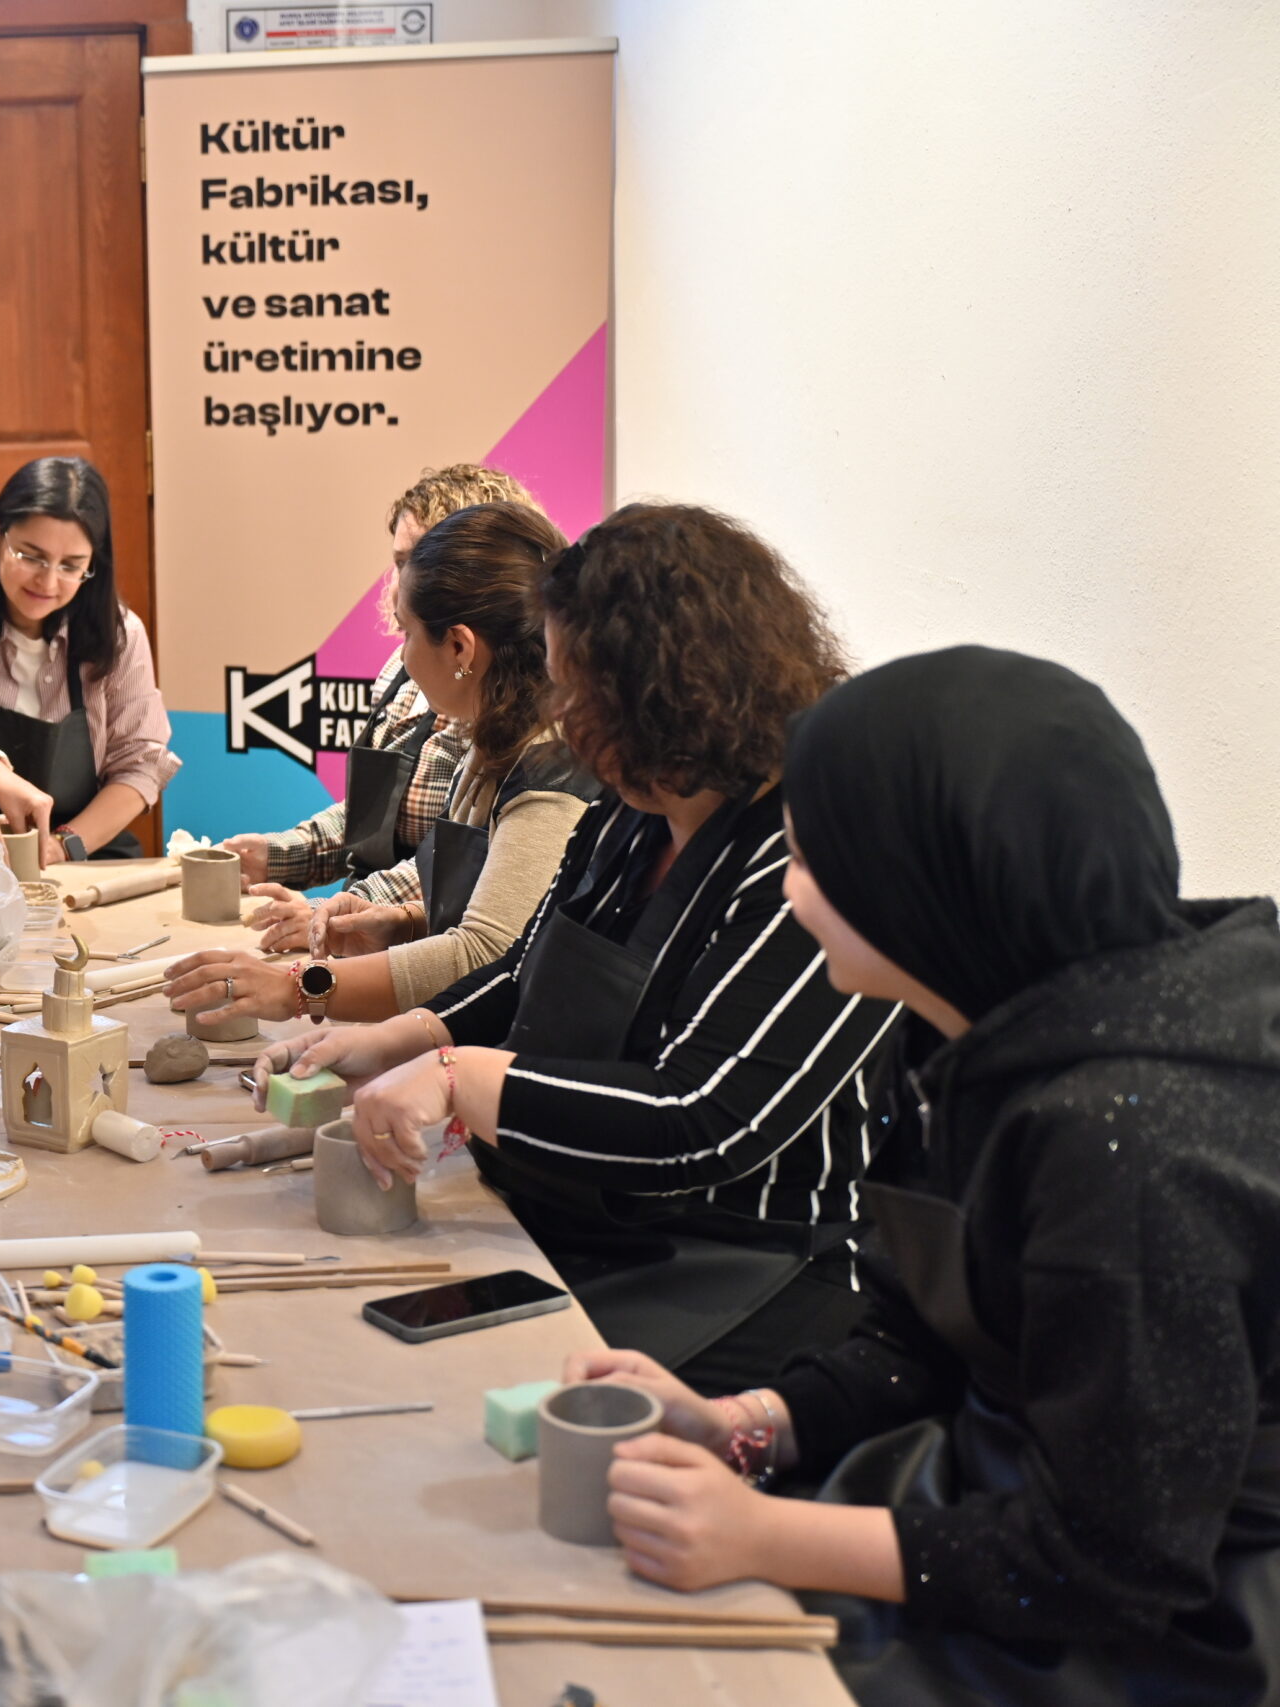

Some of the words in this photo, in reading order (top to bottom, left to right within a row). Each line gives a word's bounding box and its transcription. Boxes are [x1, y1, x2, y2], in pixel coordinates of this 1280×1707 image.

[201, 117, 345, 155] Kültür
[201, 174, 429, 211] Fabrikası,
[202, 229, 340, 265] kültür
[202, 295, 256, 319] ve
[265, 288, 390, 318] sanat
[204, 340, 422, 373] üretimine
[204, 395, 399, 437] başlıyor.
